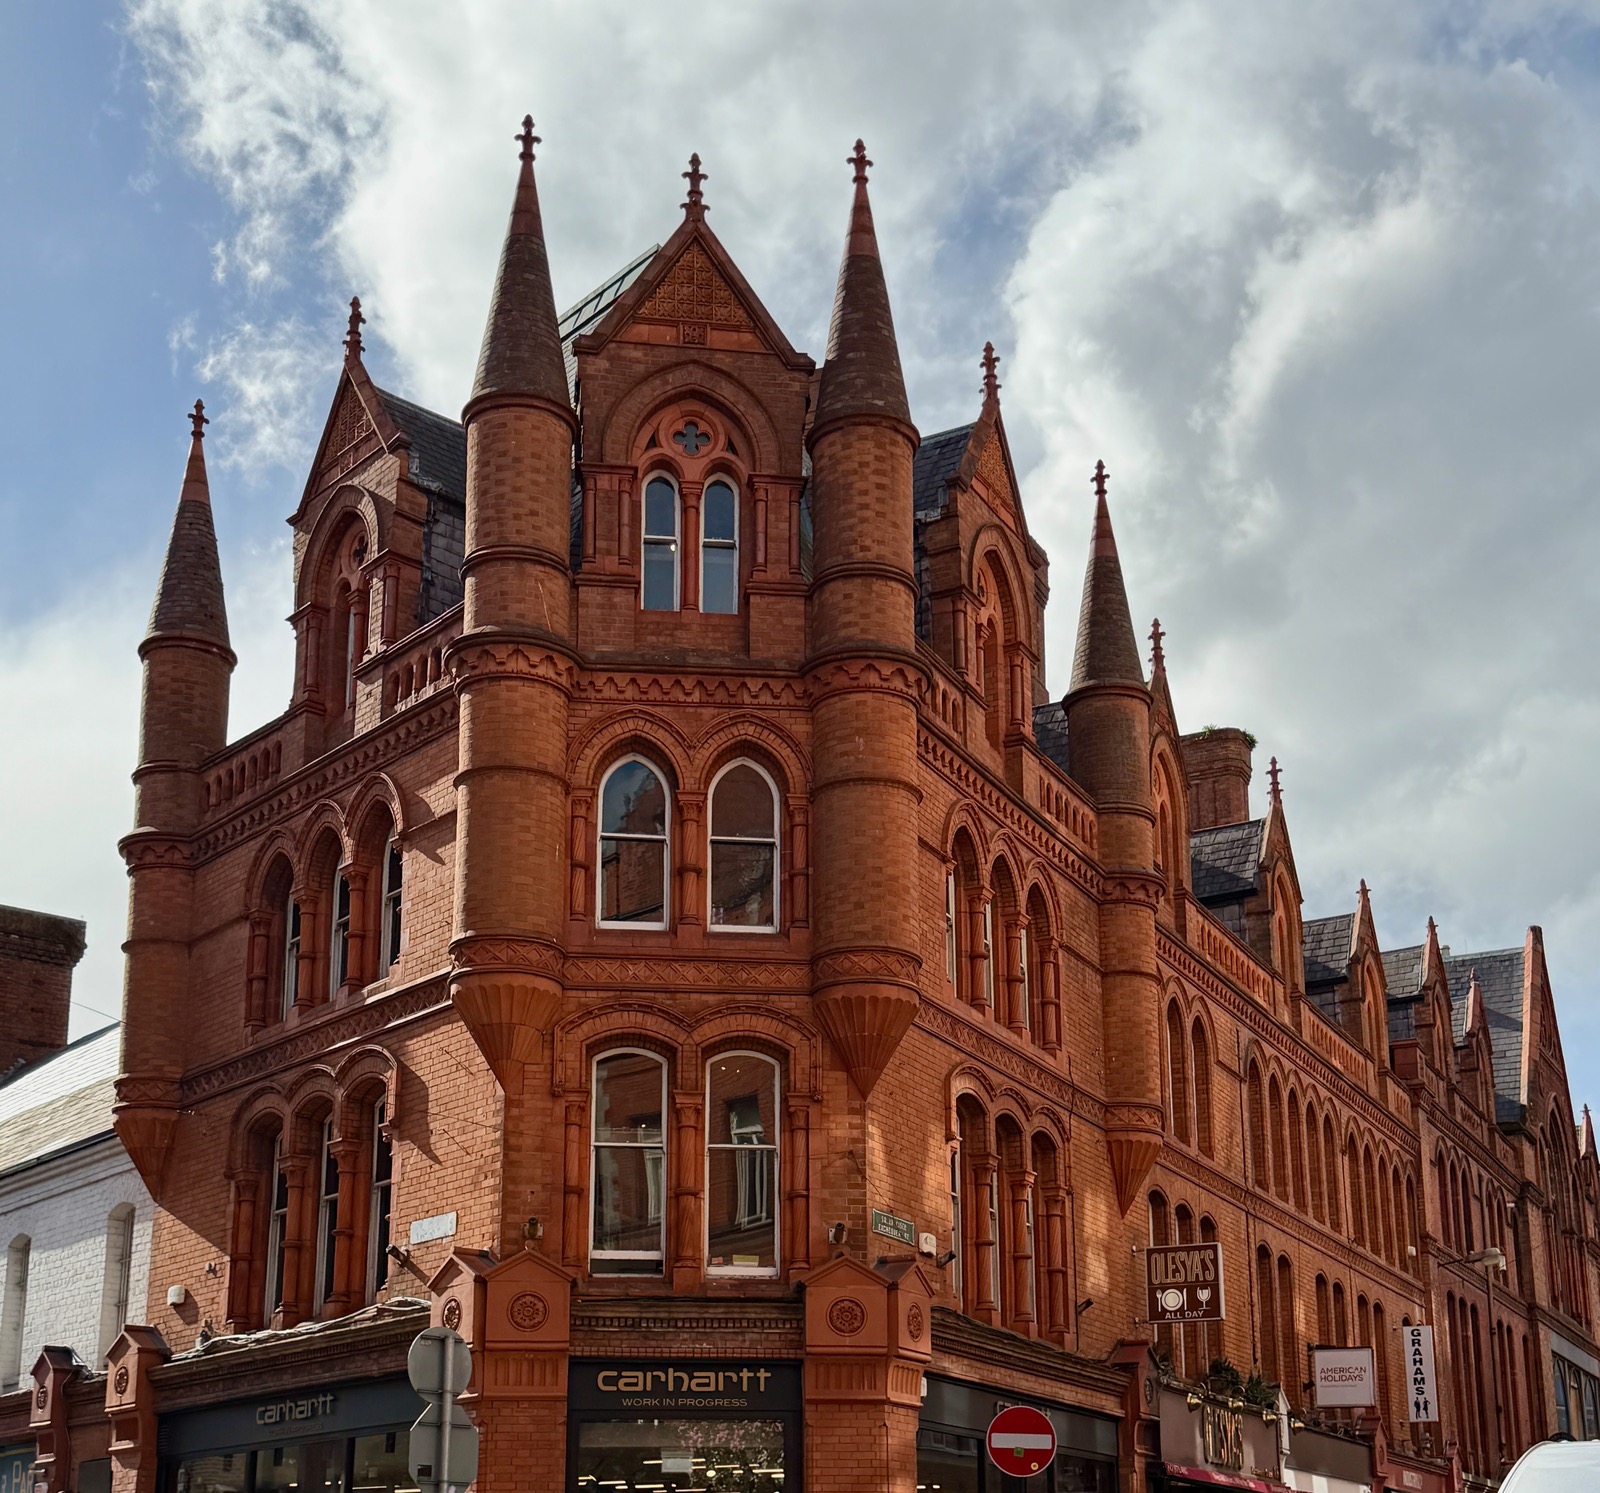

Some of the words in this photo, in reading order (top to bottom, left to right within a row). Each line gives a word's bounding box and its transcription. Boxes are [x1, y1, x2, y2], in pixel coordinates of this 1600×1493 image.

[1150, 1249, 1215, 1284] OLESYA'S
[1164, 1311, 1183, 1319] ALL
[1185, 1310, 1204, 1318] DAY
[1320, 1366, 1367, 1374] AMERICAN
[1410, 1328, 1426, 1396] GRAHAMS
[597, 1367, 771, 1392] carhartt
[1320, 1374, 1364, 1382] HOLIDAYS
[256, 1392, 335, 1425] carhartt
[622, 1398, 660, 1407] WORK
[662, 1398, 676, 1407] IN
[678, 1398, 747, 1407] PROGRESS
